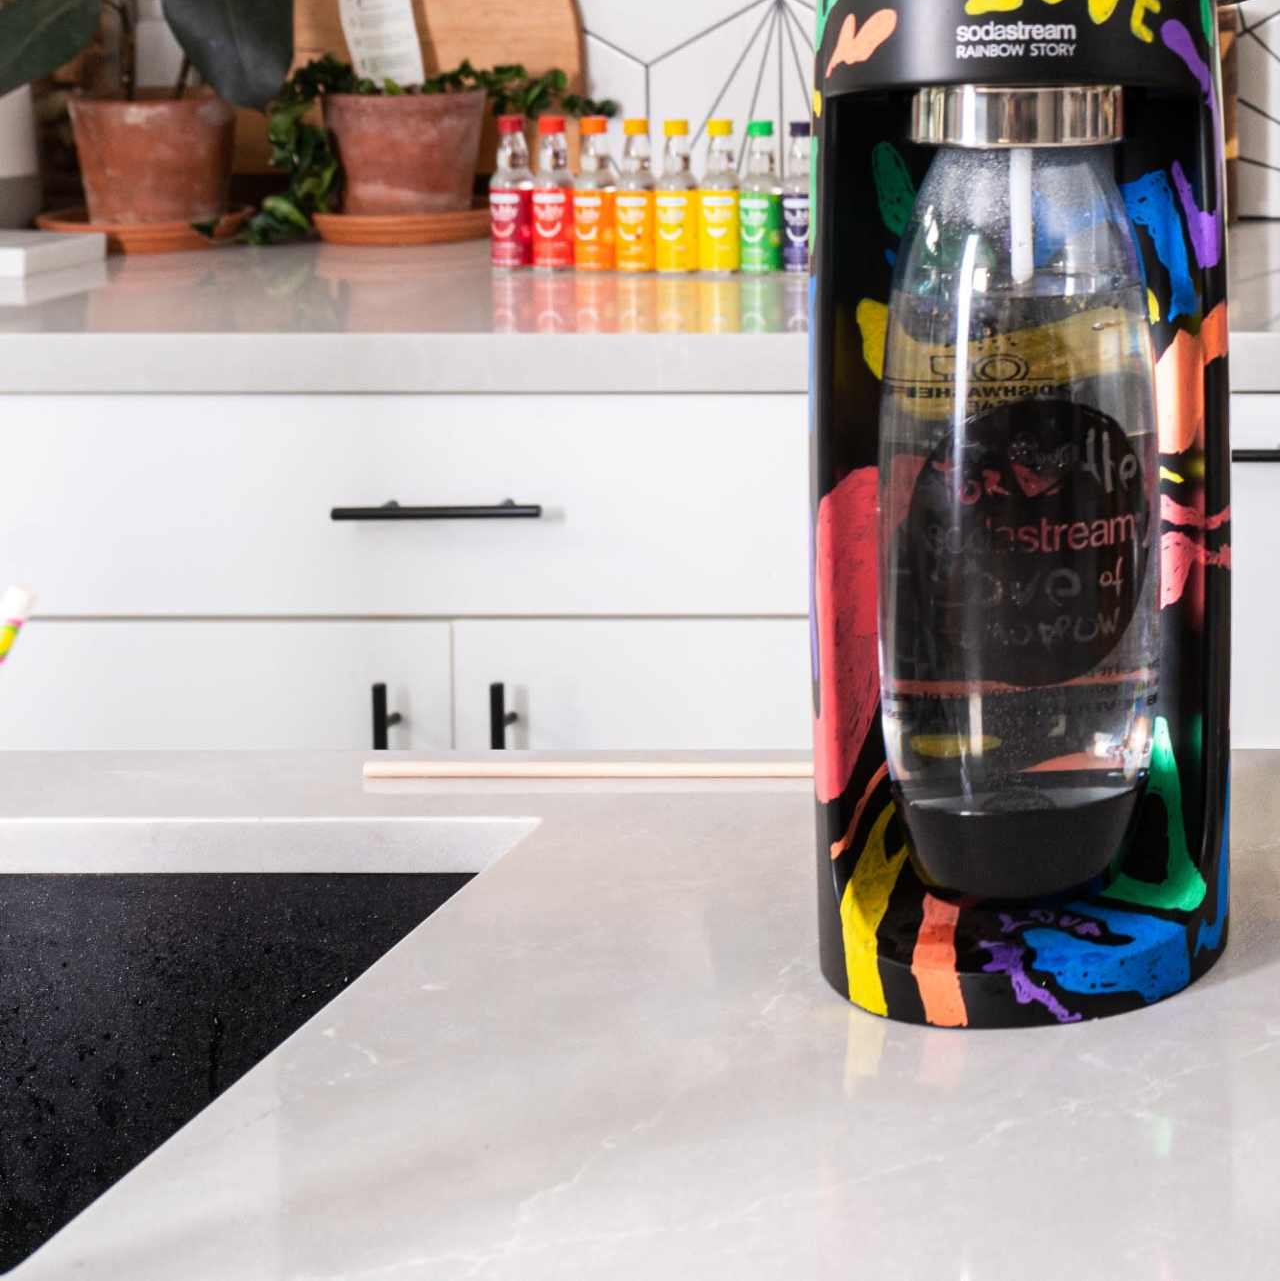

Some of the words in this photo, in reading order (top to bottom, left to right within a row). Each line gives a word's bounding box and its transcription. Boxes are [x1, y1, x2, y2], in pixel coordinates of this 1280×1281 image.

[956, 21, 1077, 42] sodastream
[956, 44, 1025, 59] RAINBOW
[1029, 43, 1077, 57] STORY
